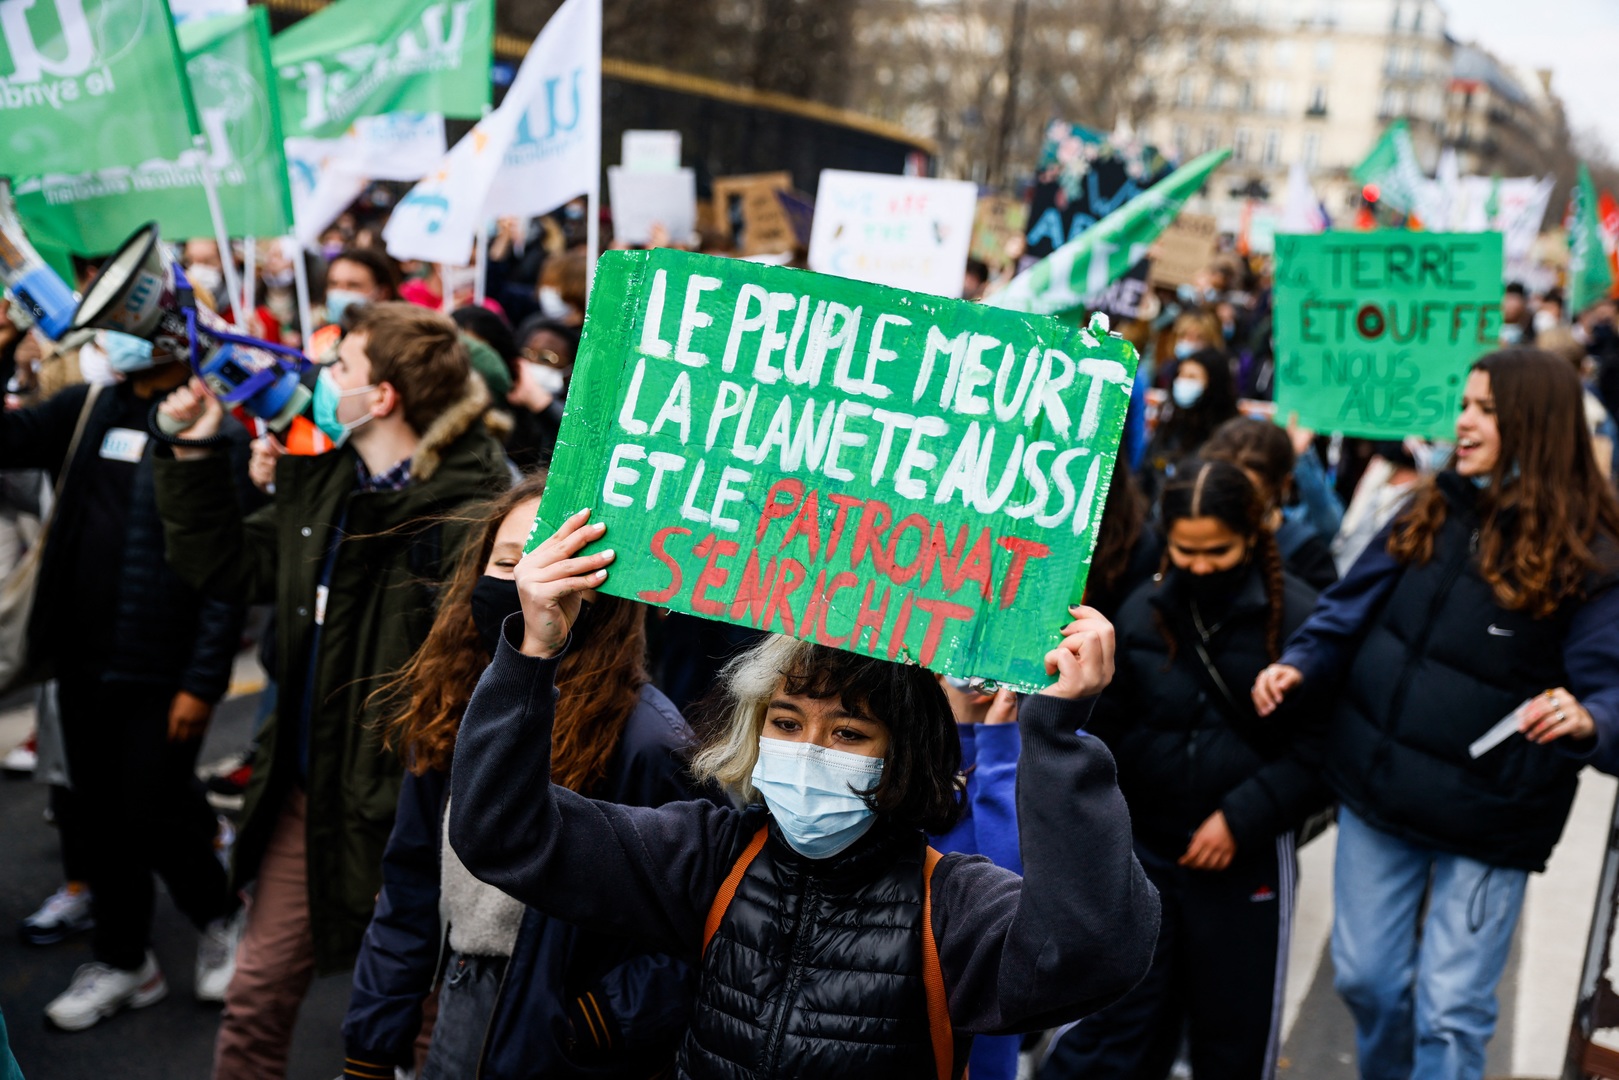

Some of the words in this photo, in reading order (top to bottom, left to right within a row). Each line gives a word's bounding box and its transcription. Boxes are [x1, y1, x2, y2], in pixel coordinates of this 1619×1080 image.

[1323, 241, 1481, 290] TERRE
[637, 268, 722, 367] LE
[722, 283, 912, 399] PEUPLE
[912, 325, 1129, 441] MEURT
[1321, 350, 1422, 387] NOUS
[618, 358, 691, 446] LA
[705, 380, 949, 499] PLANETE
[934, 421, 1101, 537] AUSSI
[602, 443, 687, 512] ET
[679, 458, 751, 532] LE
[755, 478, 1053, 611] PATRONAT
[637, 526, 975, 668] S'ENRICHIT
